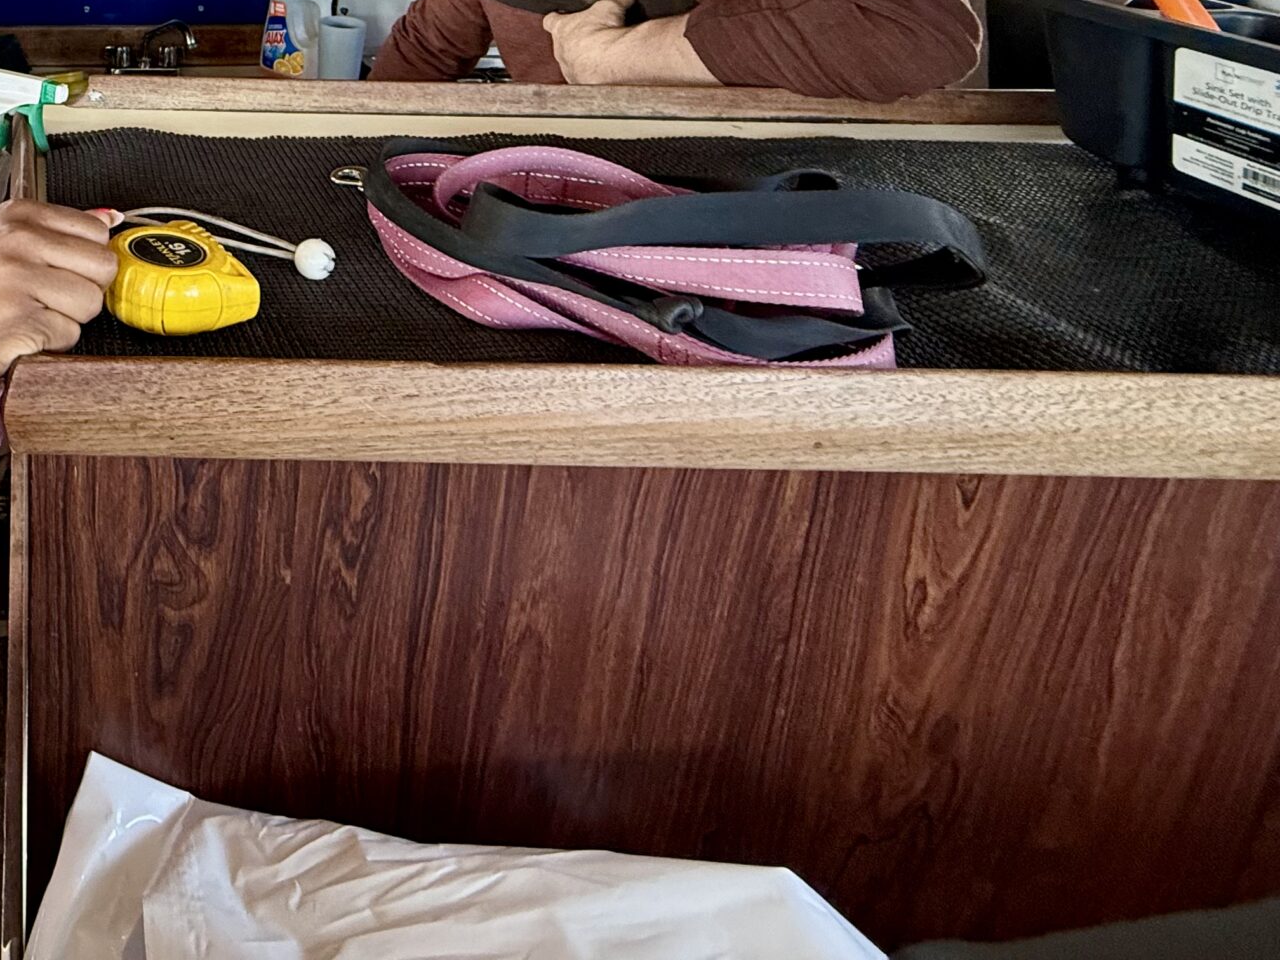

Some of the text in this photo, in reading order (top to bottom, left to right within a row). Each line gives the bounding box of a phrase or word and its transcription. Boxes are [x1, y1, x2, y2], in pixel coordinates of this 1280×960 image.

[1192, 86, 1238, 109] Slide-Out
[1239, 100, 1264, 117] Drip
[1265, 107, 1280, 123] Tra
[1205, 82, 1272, 109] Sink Set with
